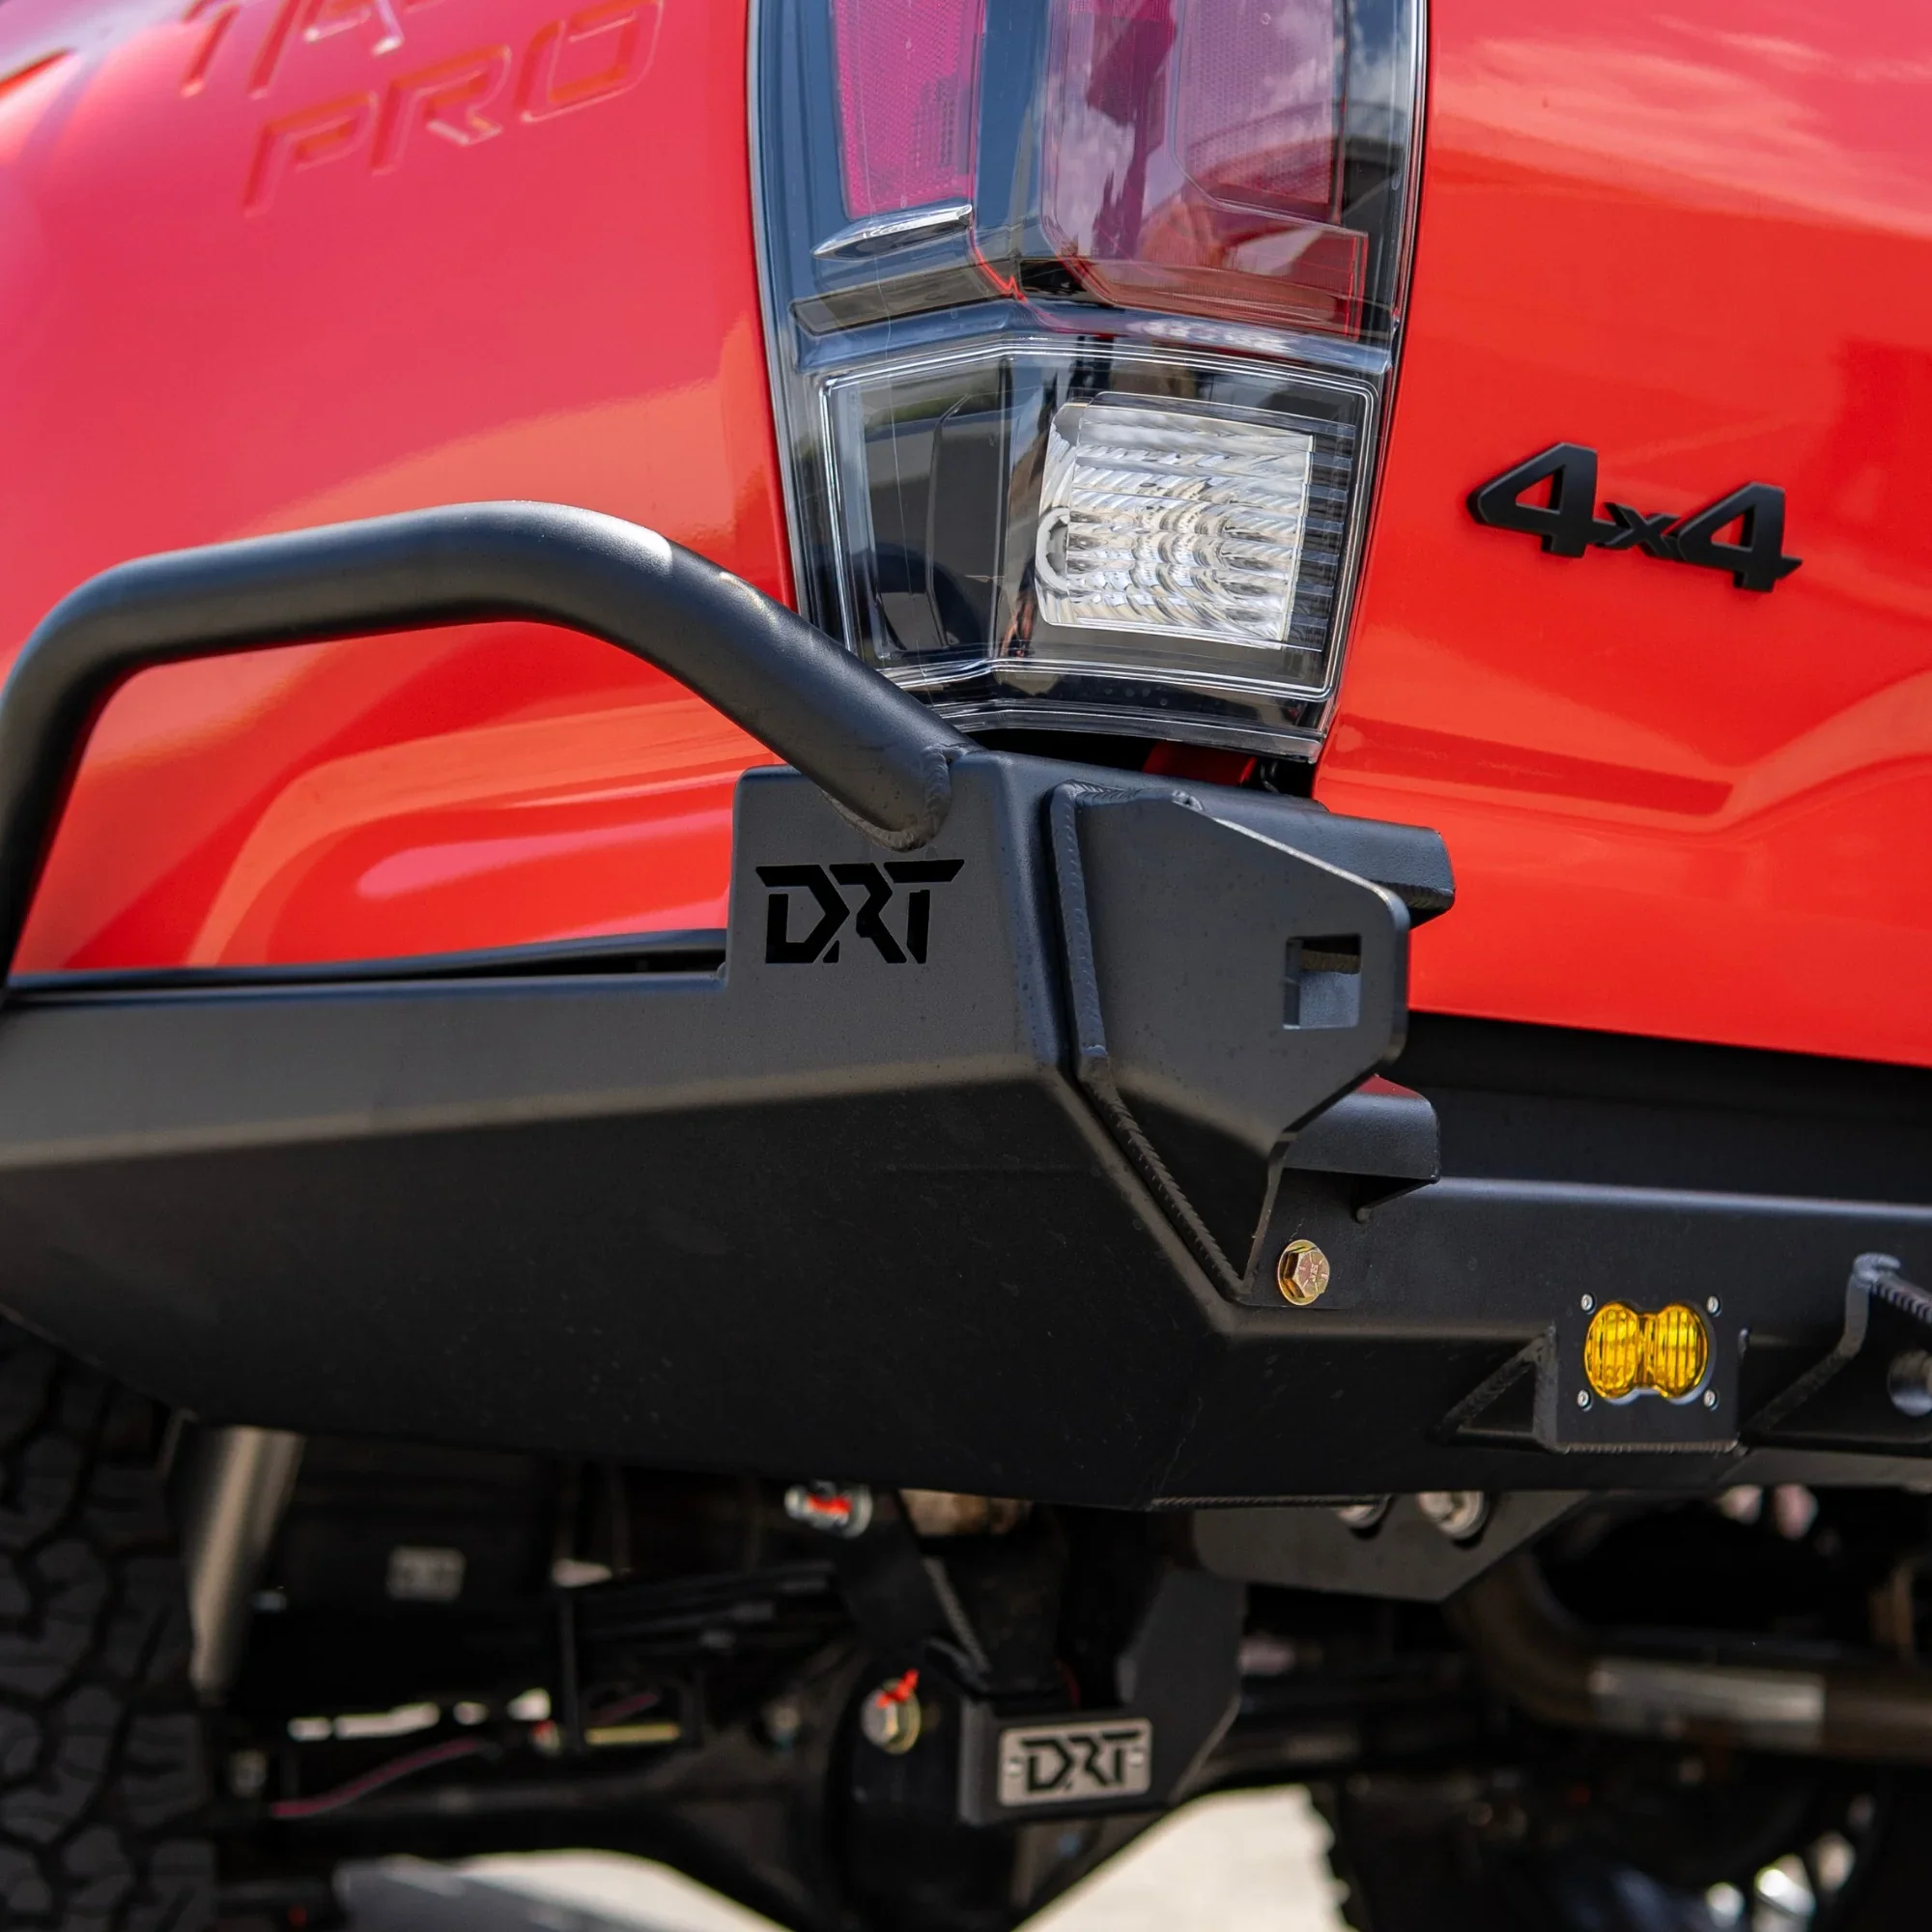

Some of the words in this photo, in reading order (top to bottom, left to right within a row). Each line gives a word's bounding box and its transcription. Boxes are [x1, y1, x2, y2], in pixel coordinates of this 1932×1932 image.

[242, 0, 665, 218] PRO
[1466, 441, 1804, 593] 4x4
[754, 859, 965, 964] DRT
[1020, 1730, 1141, 1794] DRT
